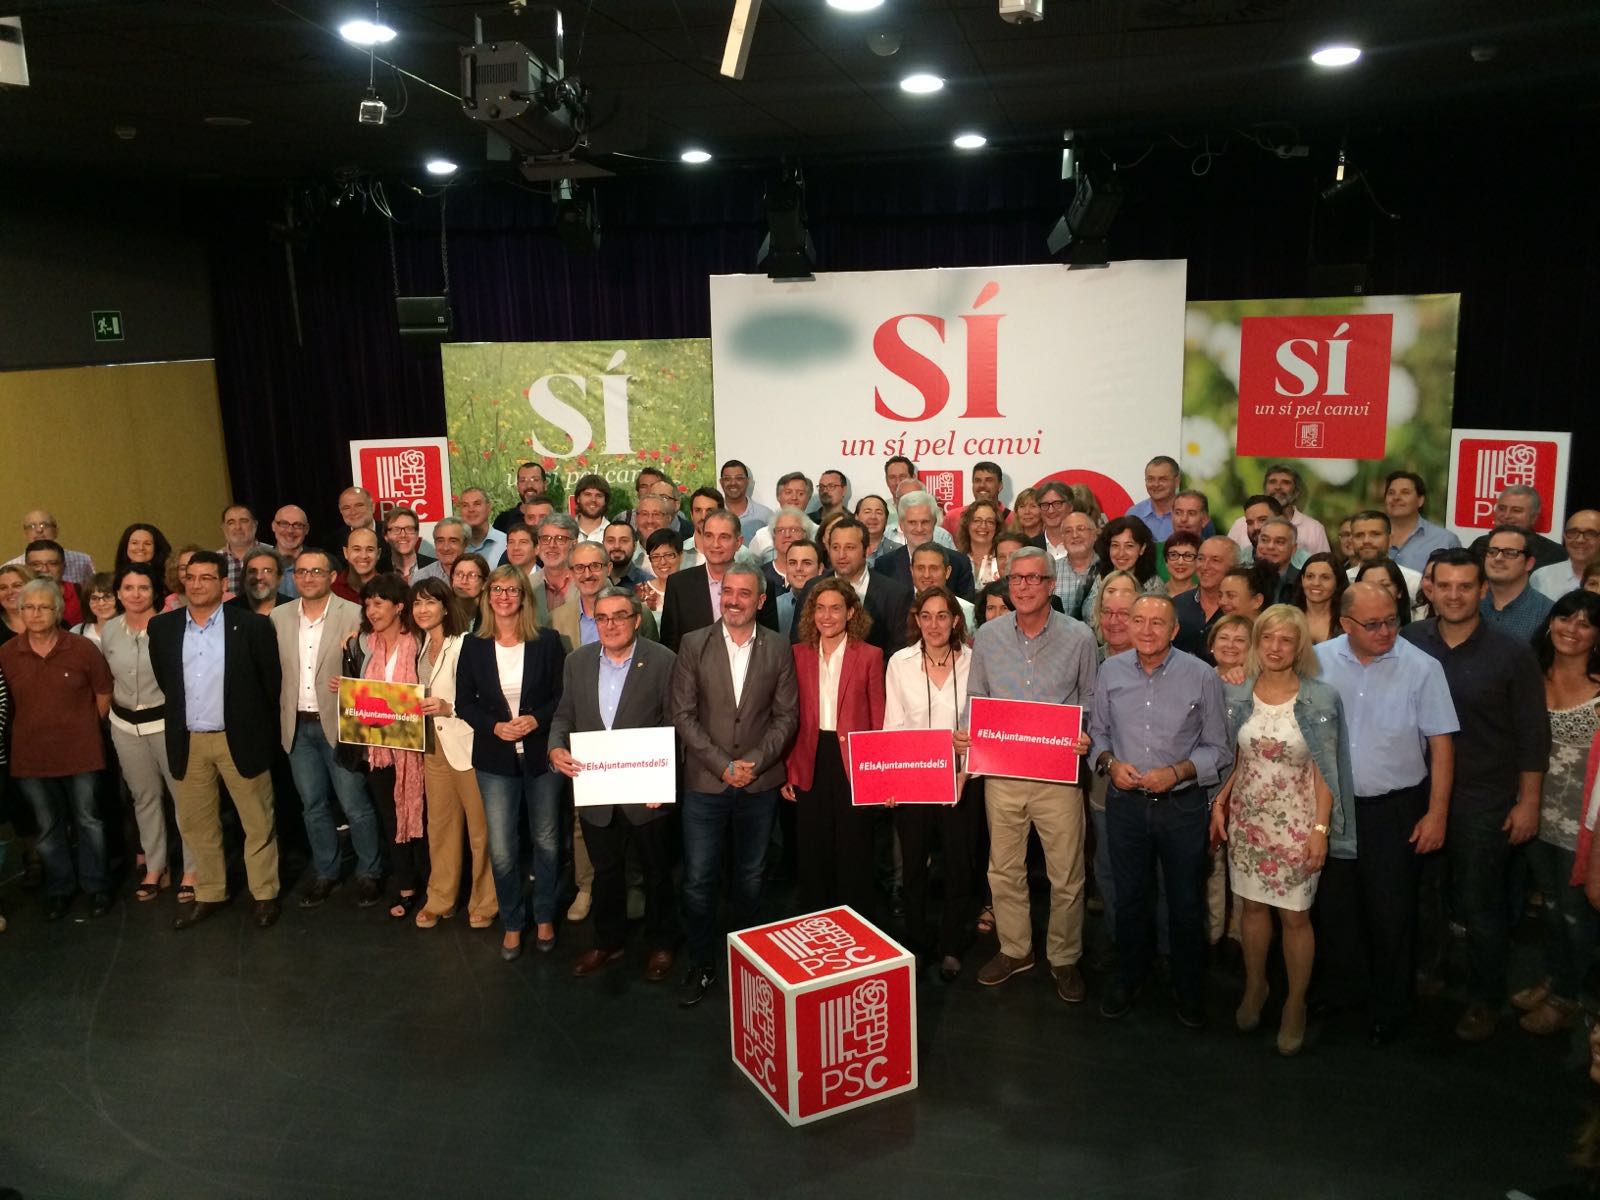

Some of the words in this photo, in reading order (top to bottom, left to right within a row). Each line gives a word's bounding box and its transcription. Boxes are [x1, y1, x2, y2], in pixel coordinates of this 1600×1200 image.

[873, 281, 1007, 422] SÍ
[1274, 322, 1352, 397] SÍ
[528, 350, 638, 459] SÍ
[1255, 404, 1275, 415] un
[1279, 401, 1293, 415] sí
[1295, 400, 1321, 419] pel
[1324, 401, 1371, 416] canvi
[840, 438, 876, 456] un
[882, 431, 907, 456] sí
[912, 430, 956, 462] pel
[963, 429, 1043, 456] canvi
[1302, 439, 1318, 447] PSC
[797, 946, 876, 976] PSC
[743, 1033, 777, 1093] PSC
[821, 1056, 888, 1105] PSC
